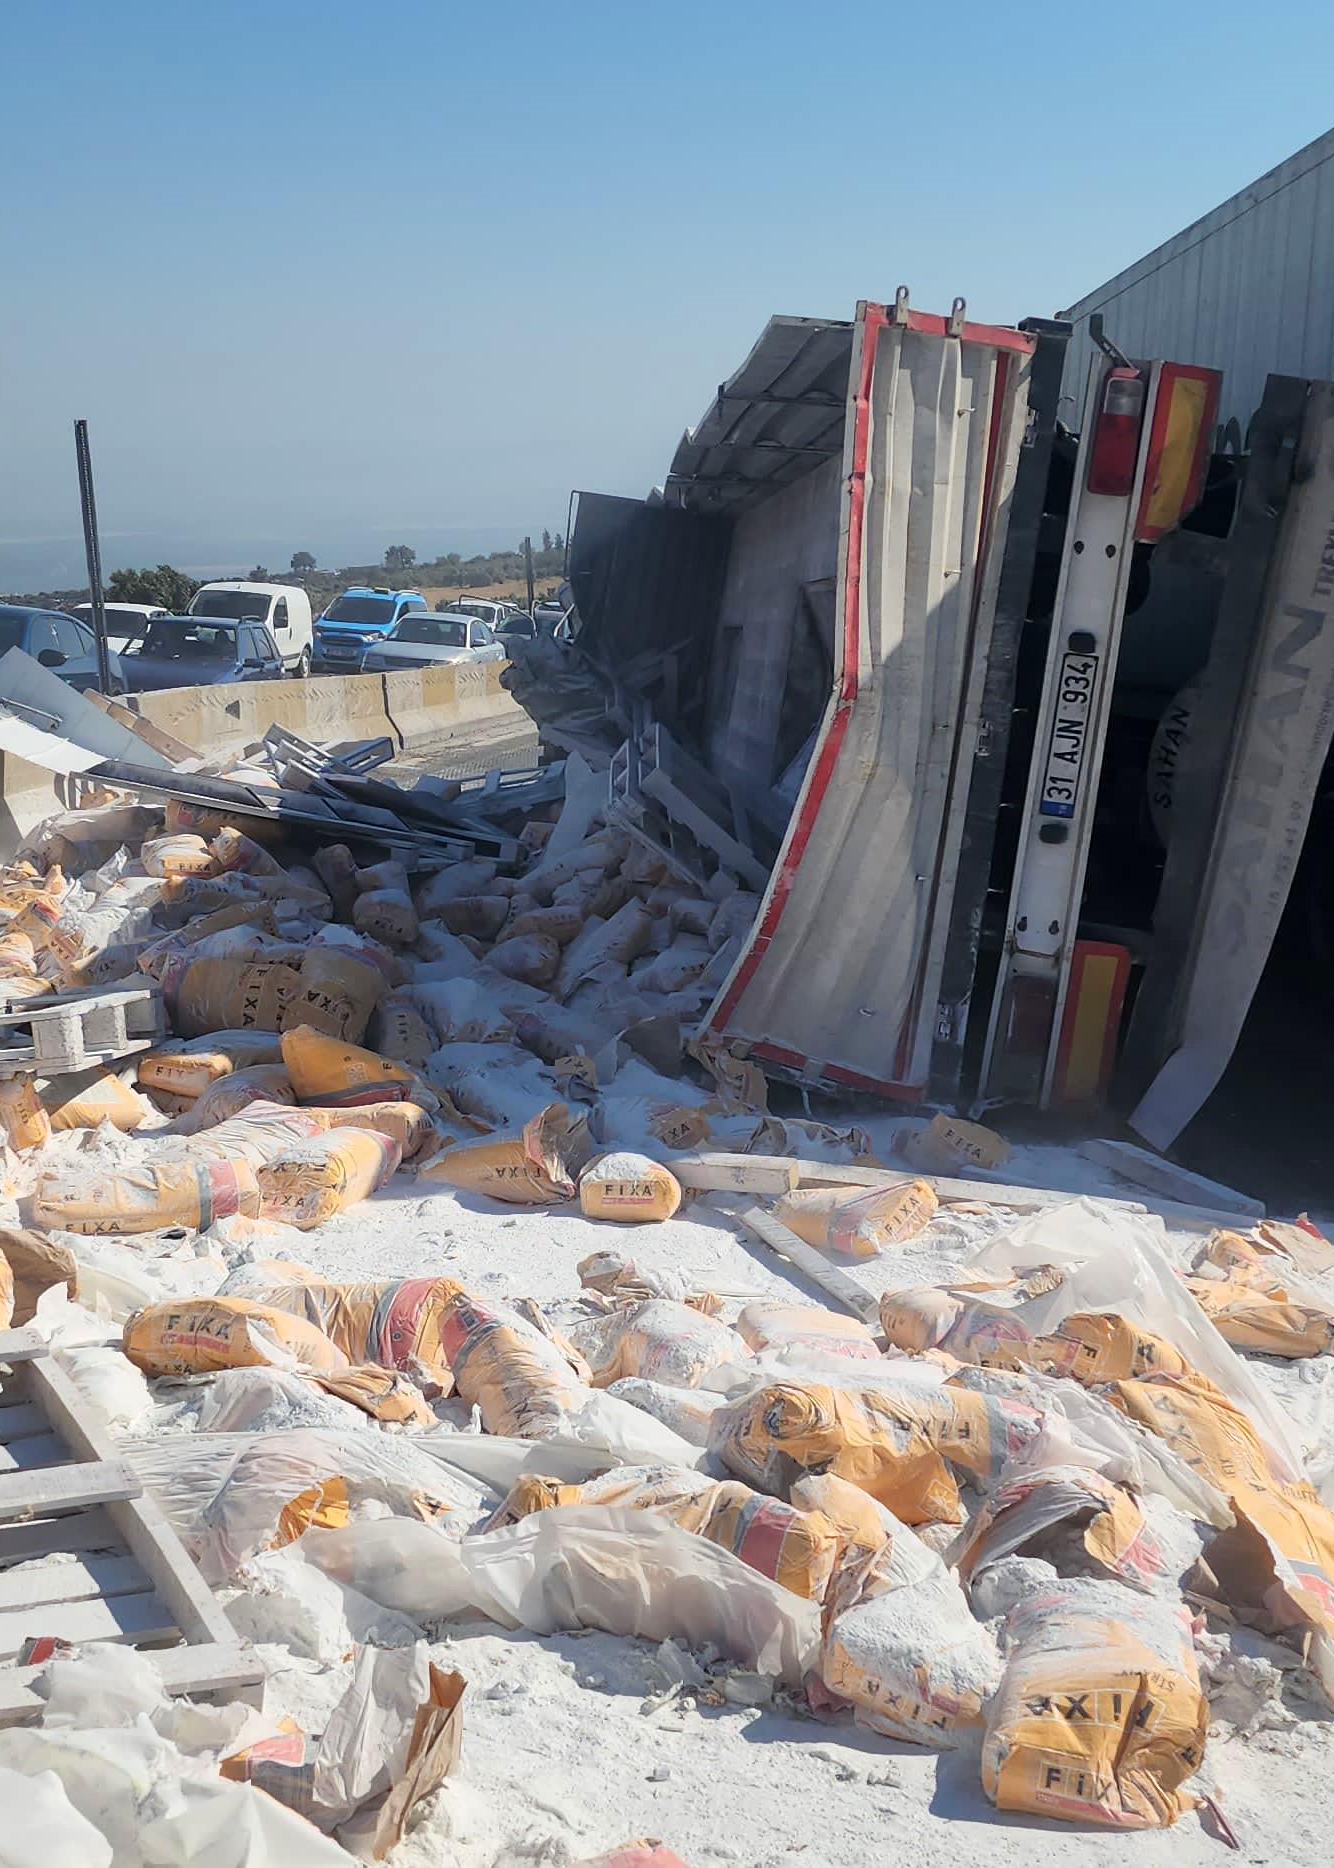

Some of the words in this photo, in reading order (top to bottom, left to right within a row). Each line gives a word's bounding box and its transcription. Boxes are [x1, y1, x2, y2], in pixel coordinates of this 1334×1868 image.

[1062, 661, 1093, 704] 934
[1054, 718, 1084, 765] AJN
[1047, 775, 1075, 801] 31
[604, 1183, 653, 1197] FIXA
[884, 1194, 922, 1237] FIXA
